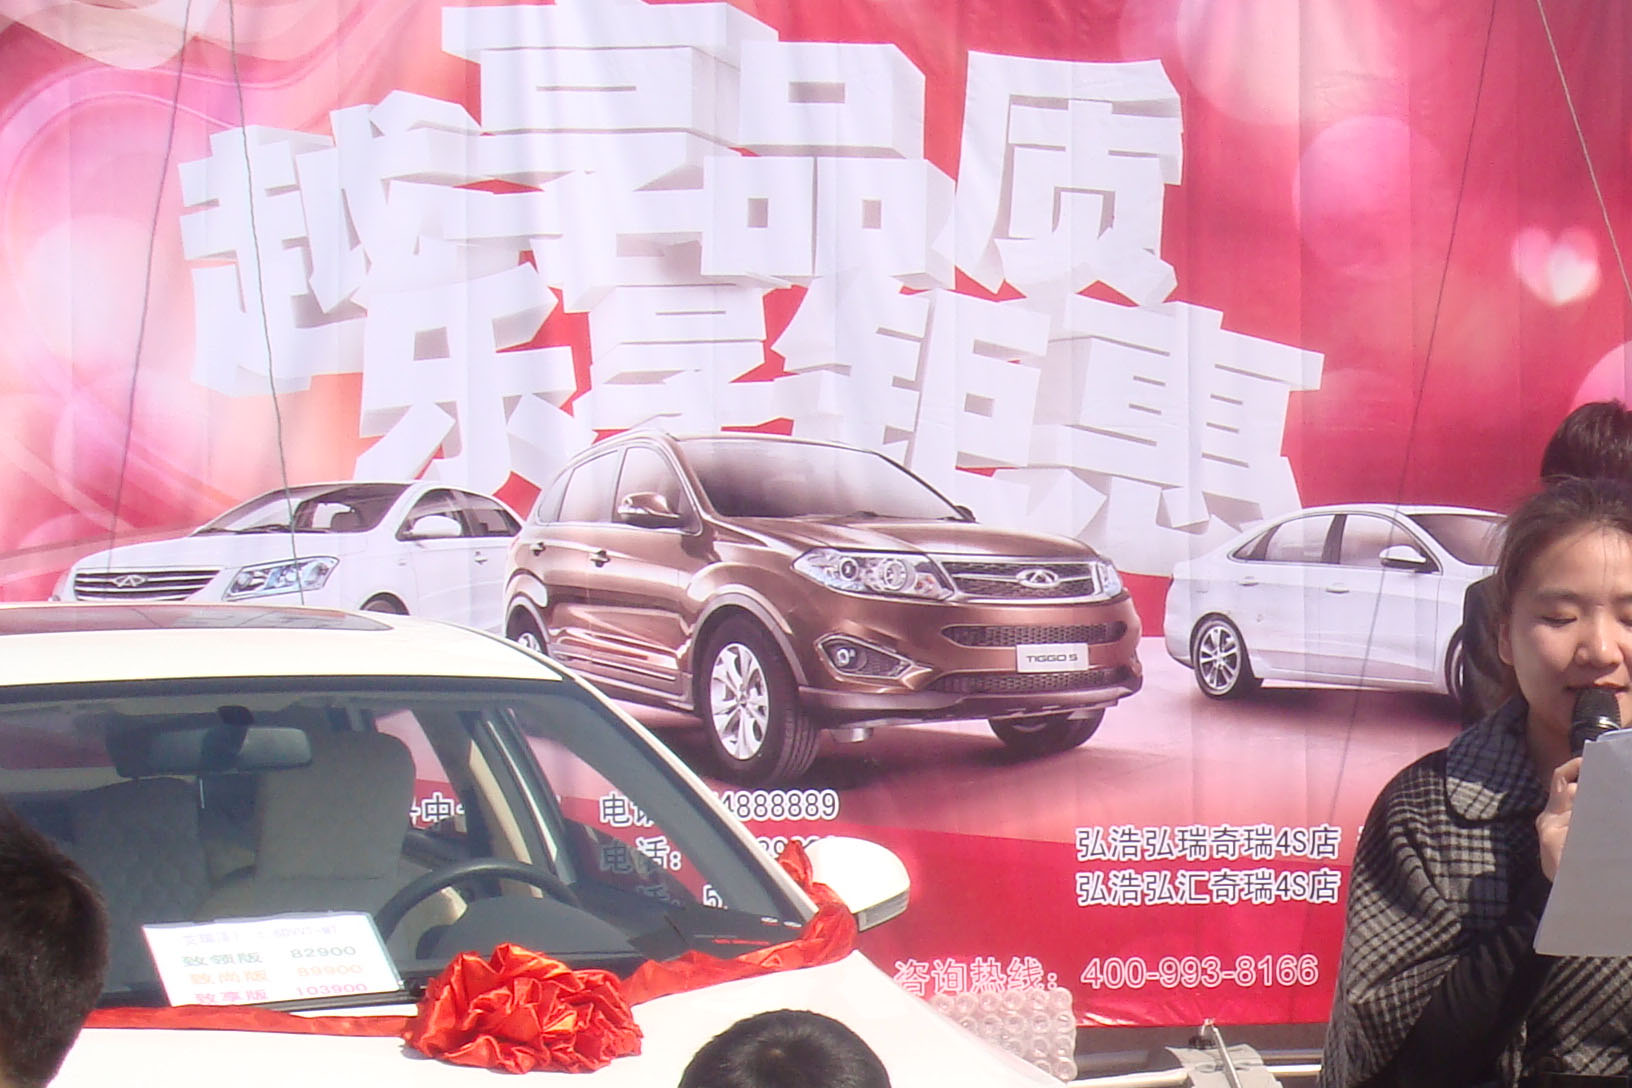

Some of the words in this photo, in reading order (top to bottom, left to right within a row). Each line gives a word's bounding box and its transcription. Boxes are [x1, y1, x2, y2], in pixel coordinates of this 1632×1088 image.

[1025, 654, 1067, 664] TIGGO
[1076, 824, 1341, 861] 弘浩弘瑞奇瑞4S店
[1076, 868, 1341, 906] 弘浩弘汇奇瑞4S店
[290, 946, 357, 960] 82900
[1080, 954, 1319, 989] 400-993-8166
[296, 983, 369, 997] 103900
